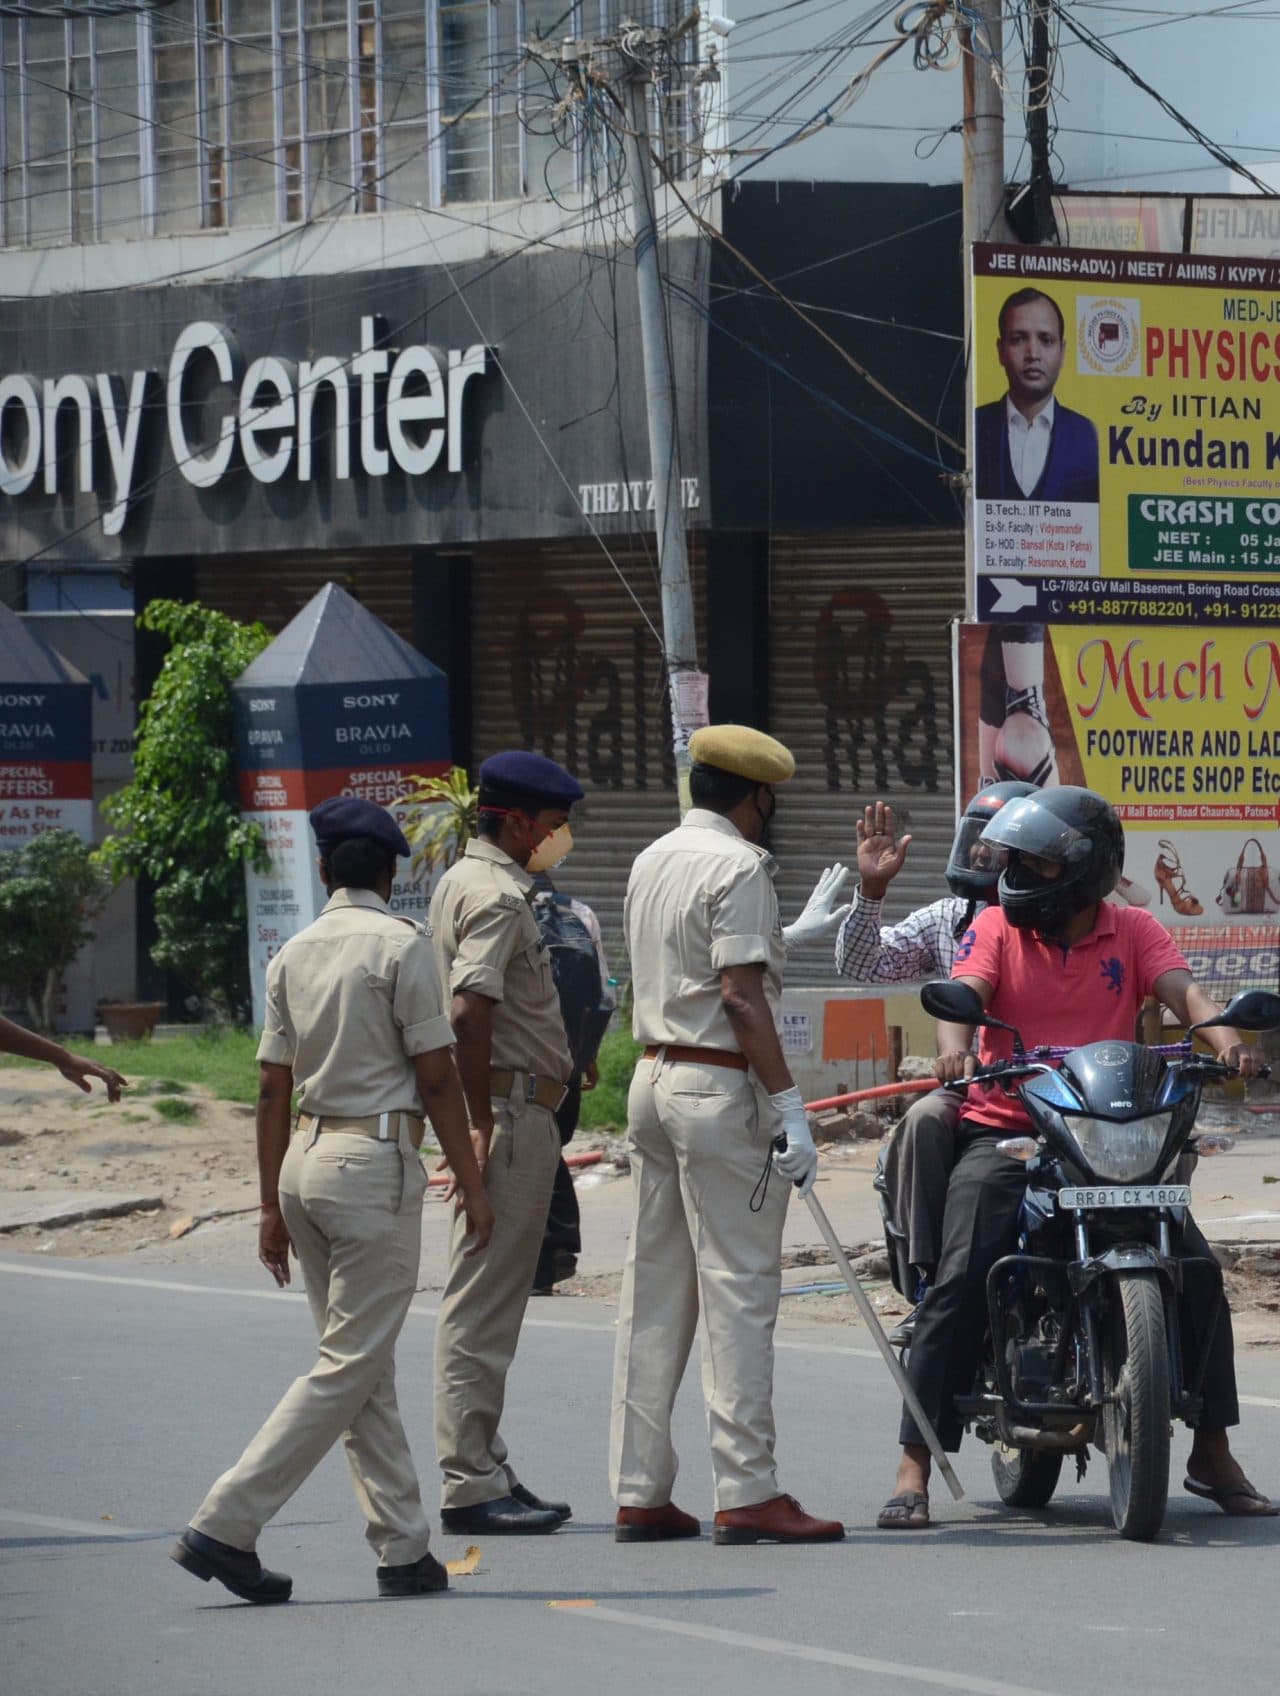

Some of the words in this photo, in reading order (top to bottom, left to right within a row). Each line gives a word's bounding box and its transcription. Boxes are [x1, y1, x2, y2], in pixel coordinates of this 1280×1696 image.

[989, 254, 1016, 270] JEE
[1020, 255, 1115, 279] (MAINS+ADV.)
[1128, 261, 1165, 278] NEET
[1176, 264, 1217, 281] AIIMS
[1228, 267, 1266, 283] KVPY
[167, 314, 499, 488] Center
[1120, 395, 1162, 421] By
[1172, 394, 1261, 420] IITIAN
[1108, 425, 1250, 469] Kundan
[579, 482, 620, 515] THE
[622, 481, 643, 513] IT
[1140, 499, 1236, 526] CRASH
[1158, 531, 1199, 545] NEET
[1240, 534, 1259, 547] 05
[1153, 550, 1184, 564] JEE
[1188, 550, 1226, 565] Main
[1240, 552, 1259, 566] 15
[1092, 580, 1108, 593] GV
[1110, 580, 1131, 594] Mall
[1133, 582, 1186, 596] Basement,
[1188, 583, 1221, 599] Boring
[1223, 585, 1250, 596] Road
[1076, 640, 1226, 720] Much
[249, 699, 276, 712] SONY
[343, 694, 400, 709] SONY
[248, 729, 283, 745] BRAVIA
[336, 723, 412, 743] BRAVIA
[1087, 729, 1194, 758] FOOTWEAR
[1201, 731, 1241, 758] AND
[350, 771, 402, 785] SPECIAL
[1121, 766, 1185, 793] PURCE
[1193, 767, 1245, 794] SHOP
[11, 806, 31, 819] As
[36, 806, 62, 820] Per
[1128, 805, 1145, 818] Mall
[1148, 805, 1174, 821] Boring
[1177, 806, 1198, 818] Road
[1200, 806, 1242, 820] Chauraha,
[1245, 806, 1276, 818] Patna-1
[783, 1015, 807, 1025] LET
[1123, 1191, 1142, 1205] CX
